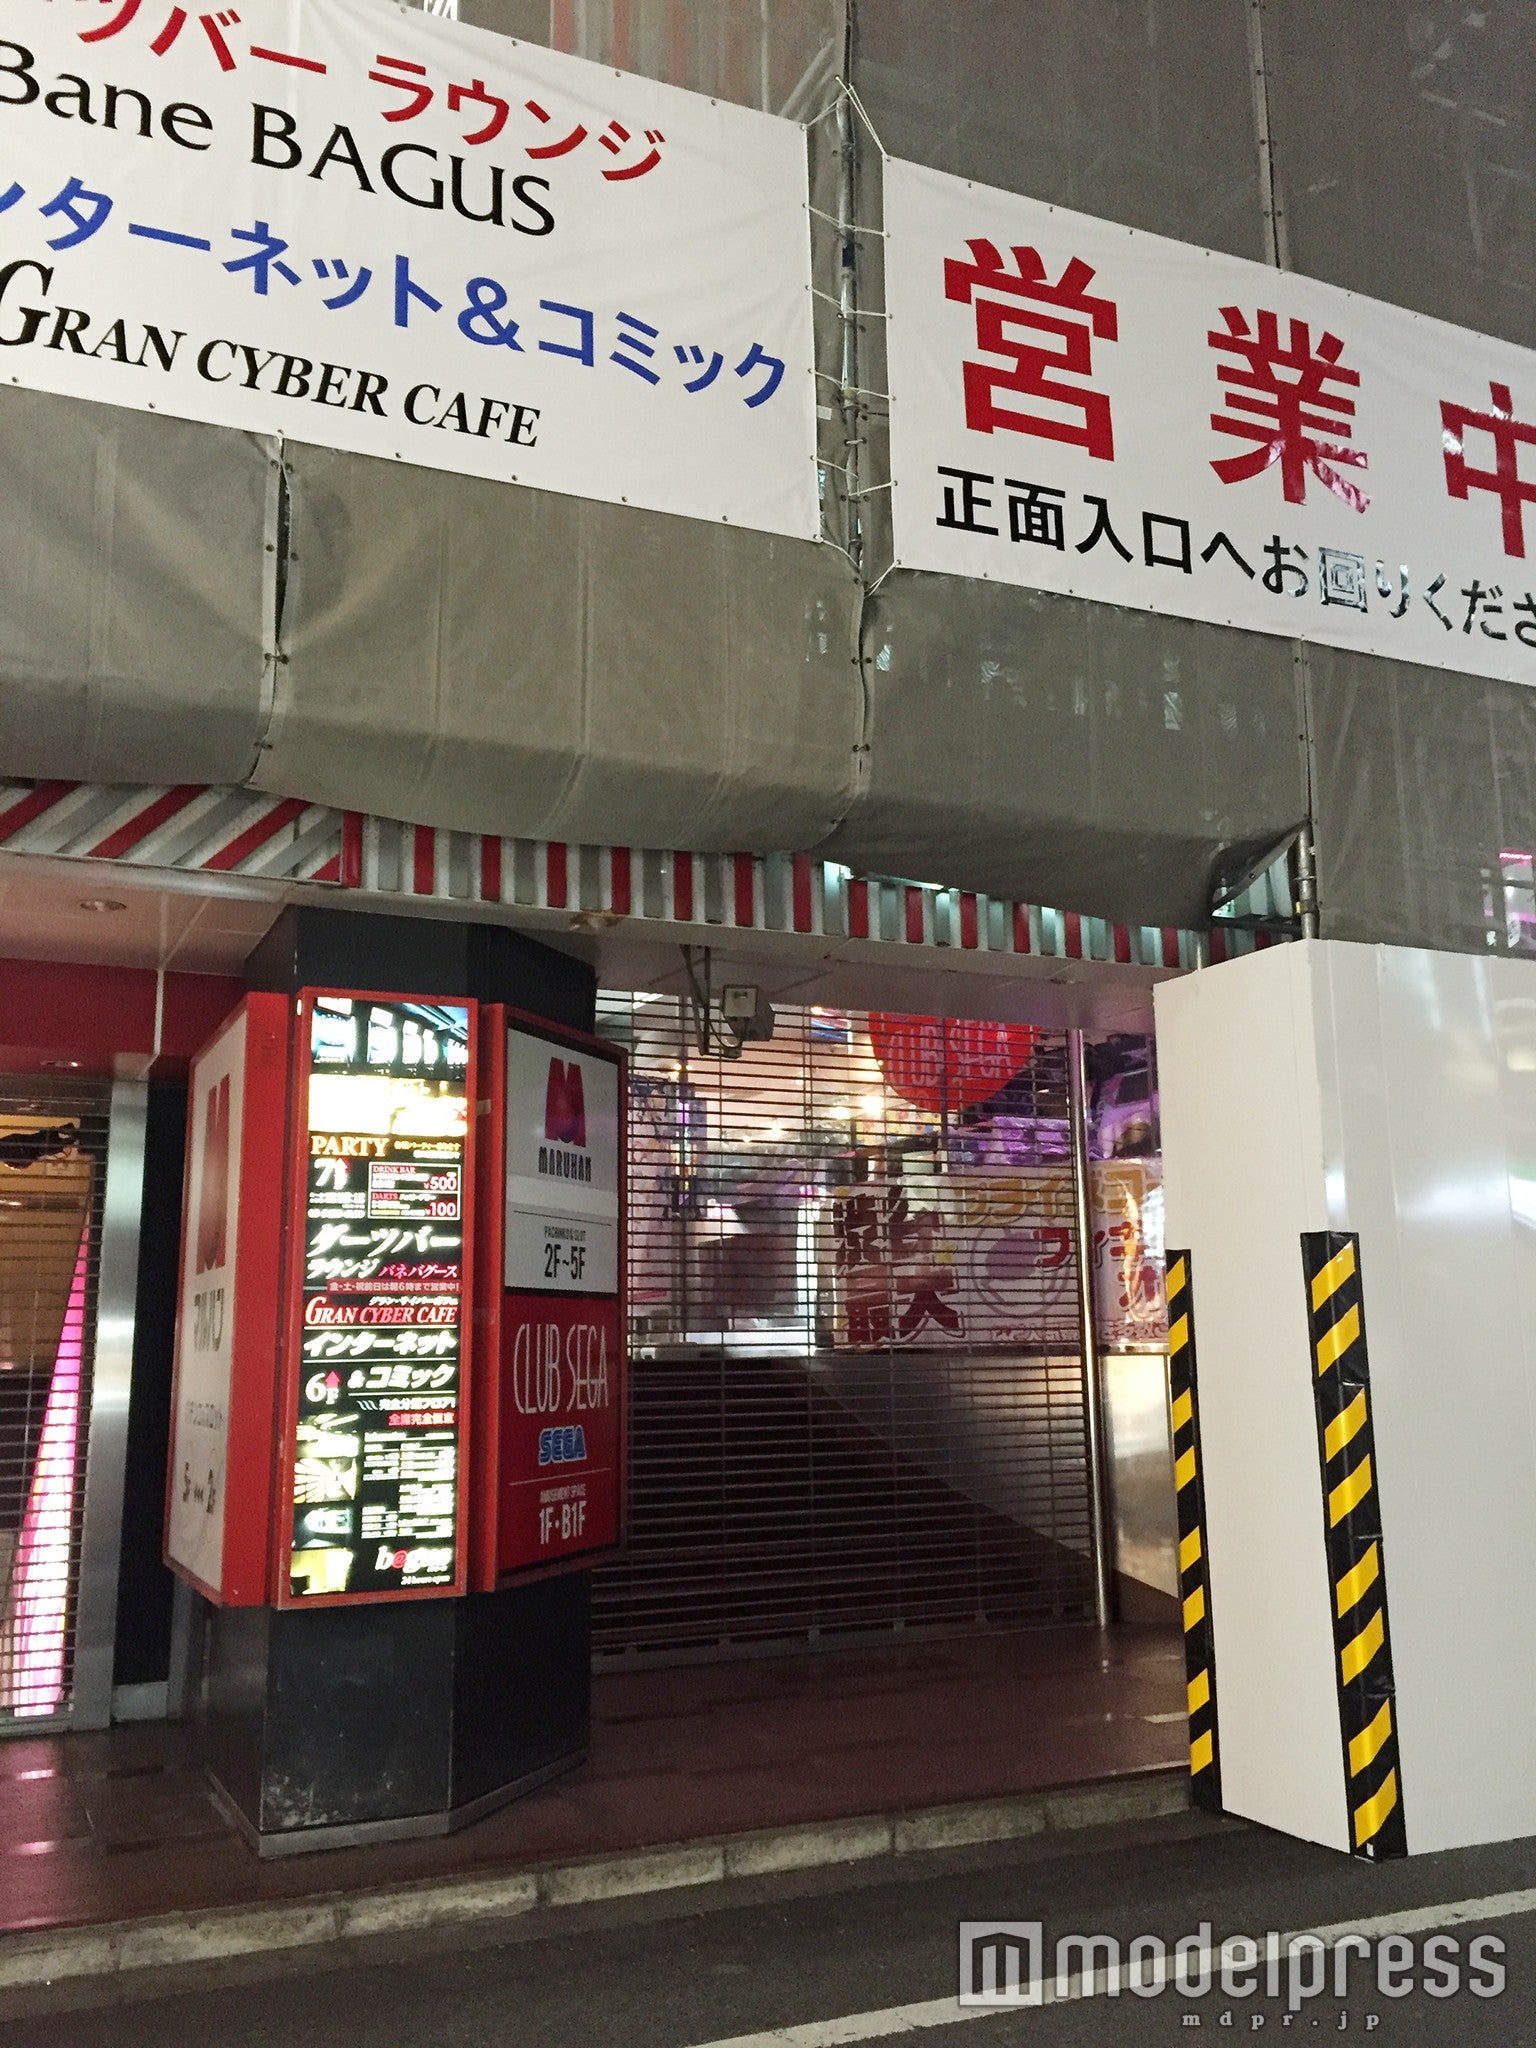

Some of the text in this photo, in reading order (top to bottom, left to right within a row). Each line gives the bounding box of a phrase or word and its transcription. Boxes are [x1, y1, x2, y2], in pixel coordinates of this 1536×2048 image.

[369, 54, 666, 182] ラウンジ
[0, 39, 556, 237] Bane BAGUS
[0, 176, 786, 409] ターネット&コミック
[0, 259, 542, 448] GRAN CYBER CAFE
[943, 237, 1536, 560] 営業中
[310, 1135, 390, 1157] PARTY
[538, 1145, 592, 1183] MARUHAN
[372, 1166, 398, 1174] DRINK
[372, 1192, 399, 1201] DARTS
[306, 1223, 461, 1258] ダーツバー
[306, 1258, 381, 1280] ラウンジ
[305, 1296, 458, 1325] GRAN CYBER CAFE
[303, 1330, 458, 1357] インターネット
[347, 1363, 456, 1389] &コミック
[513, 1323, 609, 1414] CLUB SEGA
[538, 1424, 587, 1466] SEGA
